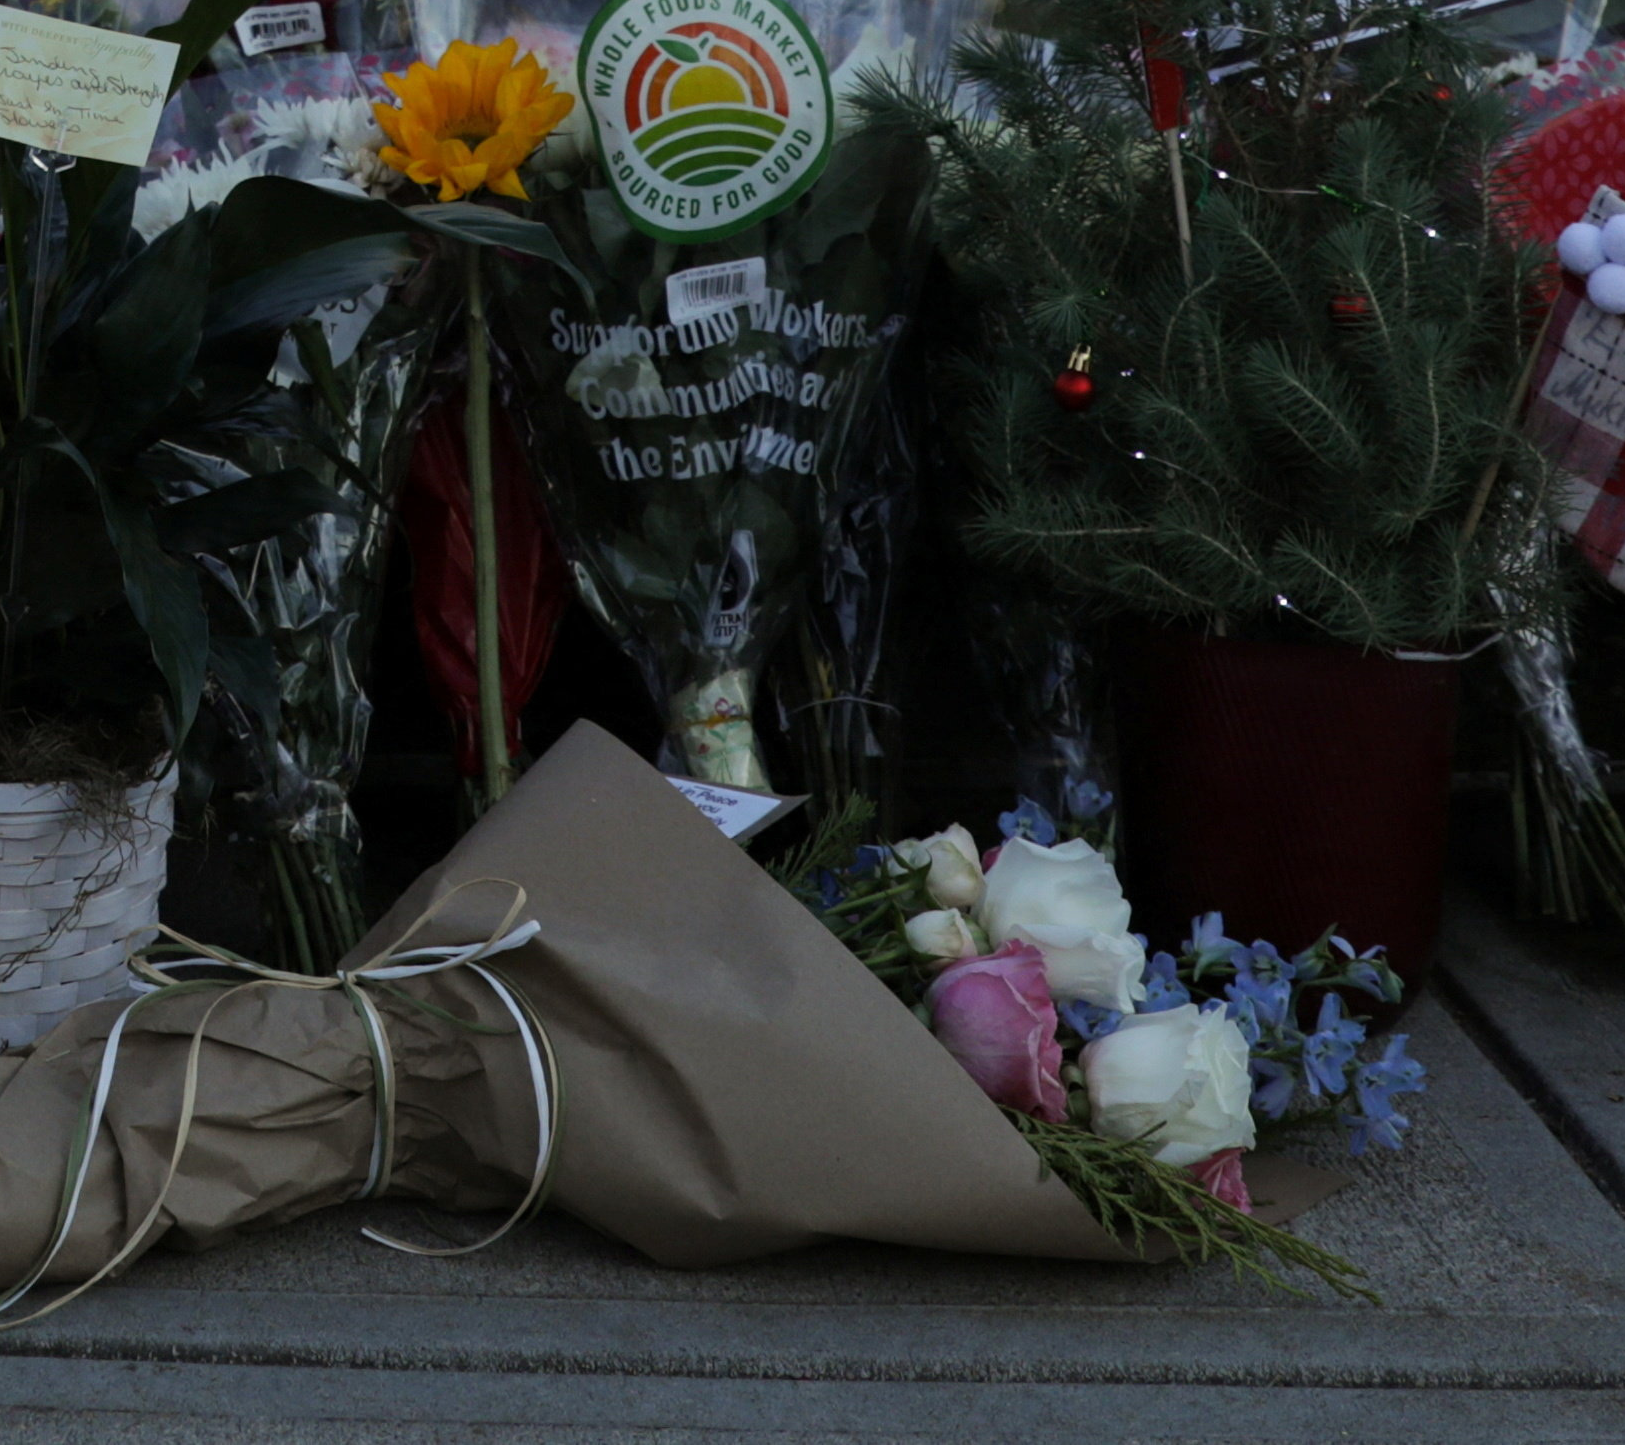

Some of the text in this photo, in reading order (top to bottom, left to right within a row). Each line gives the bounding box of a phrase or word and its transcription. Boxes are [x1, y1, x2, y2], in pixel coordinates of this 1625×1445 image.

[1, 21, 30, 34] WITH
[31, 27, 79, 46] DEEPEST
[594, 18, 642, 97] WHOLE
[67, 106, 125, 124] Time
[612, 129, 812, 218] SOURCED FOR GOOD
[599, 436, 663, 482] the
